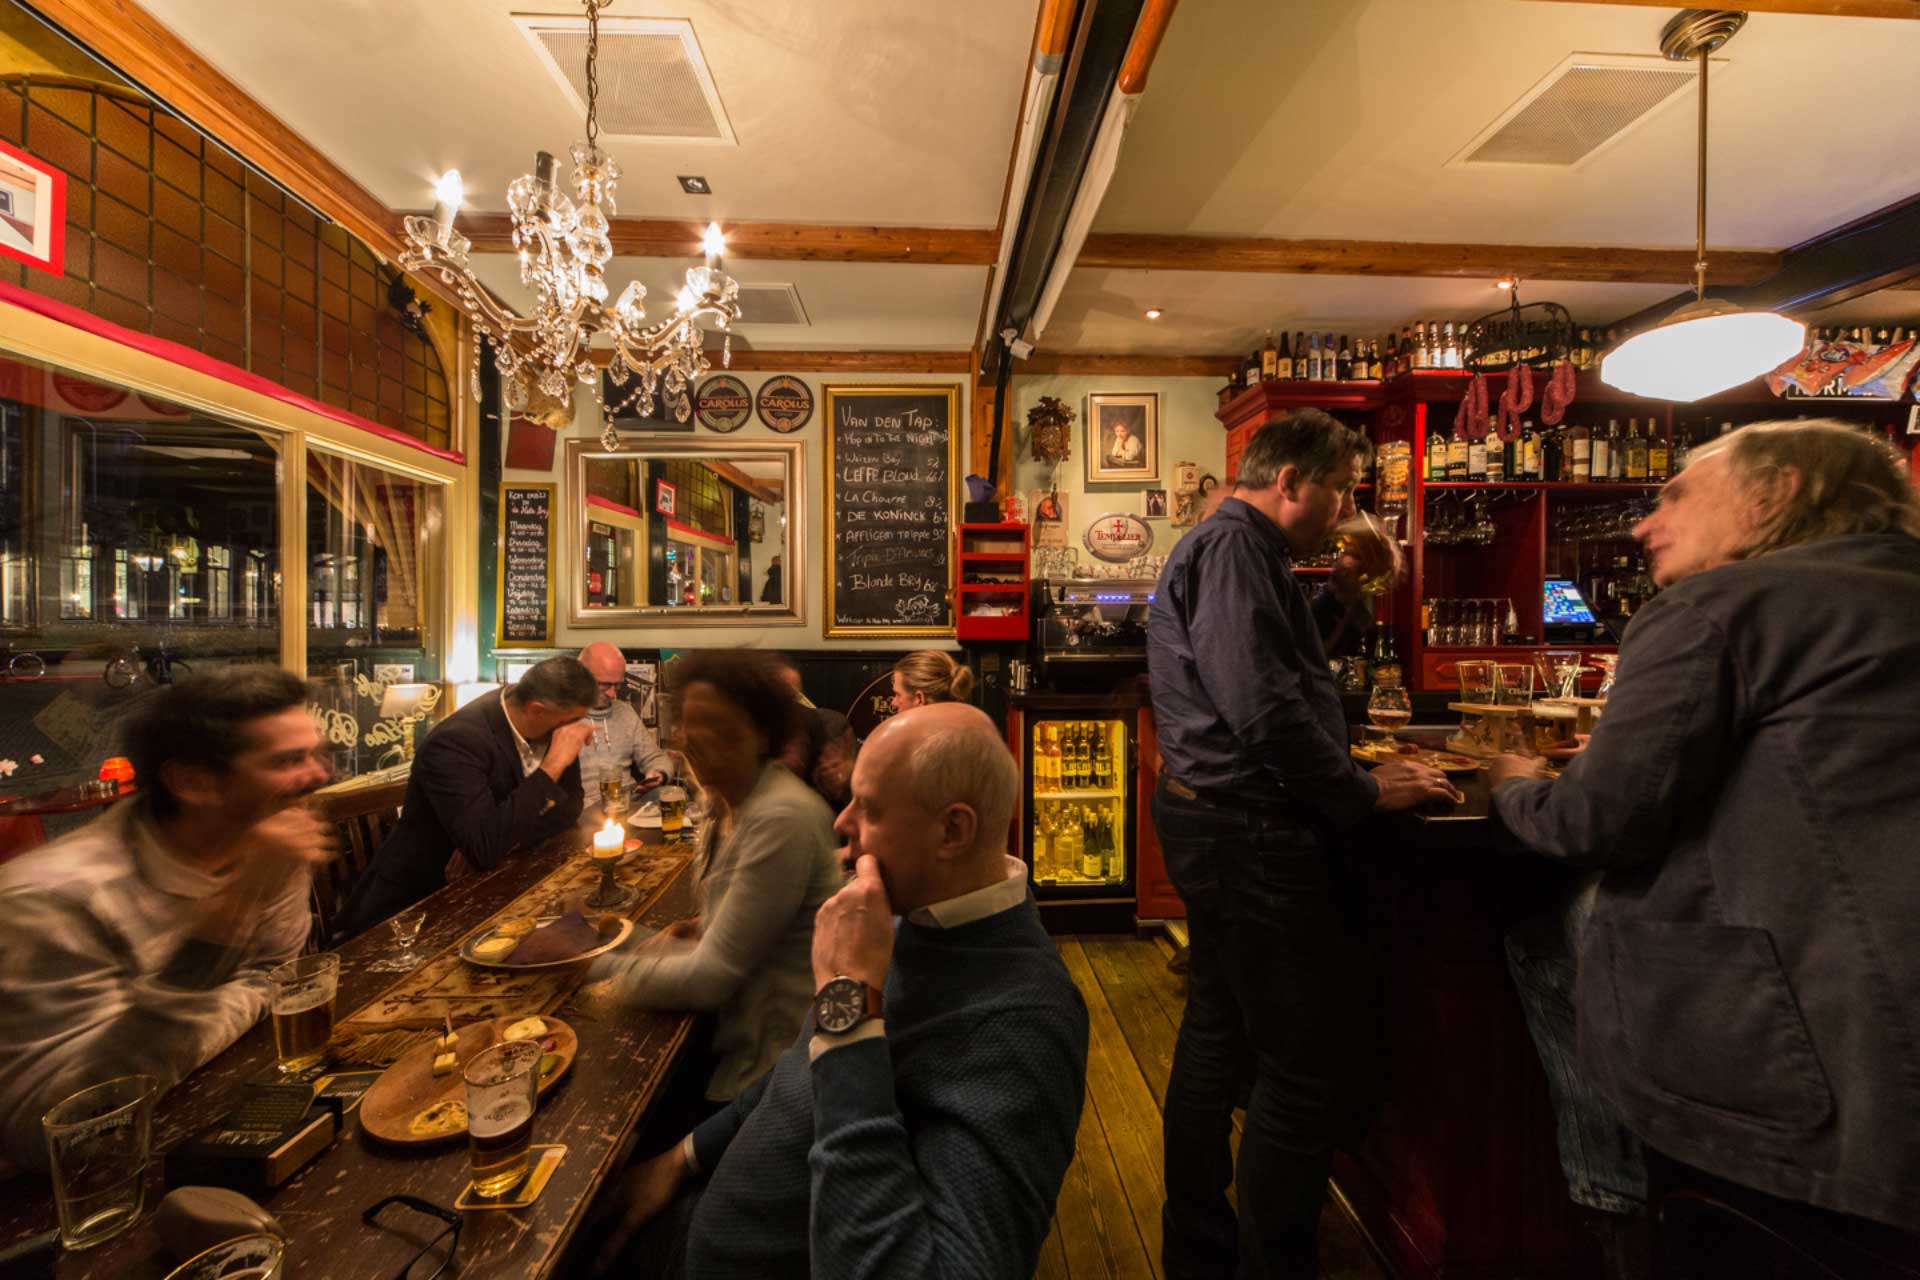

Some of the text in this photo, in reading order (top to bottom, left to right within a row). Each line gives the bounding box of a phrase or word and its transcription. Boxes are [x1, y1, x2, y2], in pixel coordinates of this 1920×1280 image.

[699, 398, 749, 410] CAROLUS
[760, 398, 810, 411] CAROLUS
[875, 416, 901, 429] DEN
[847, 511, 867, 523] DE
